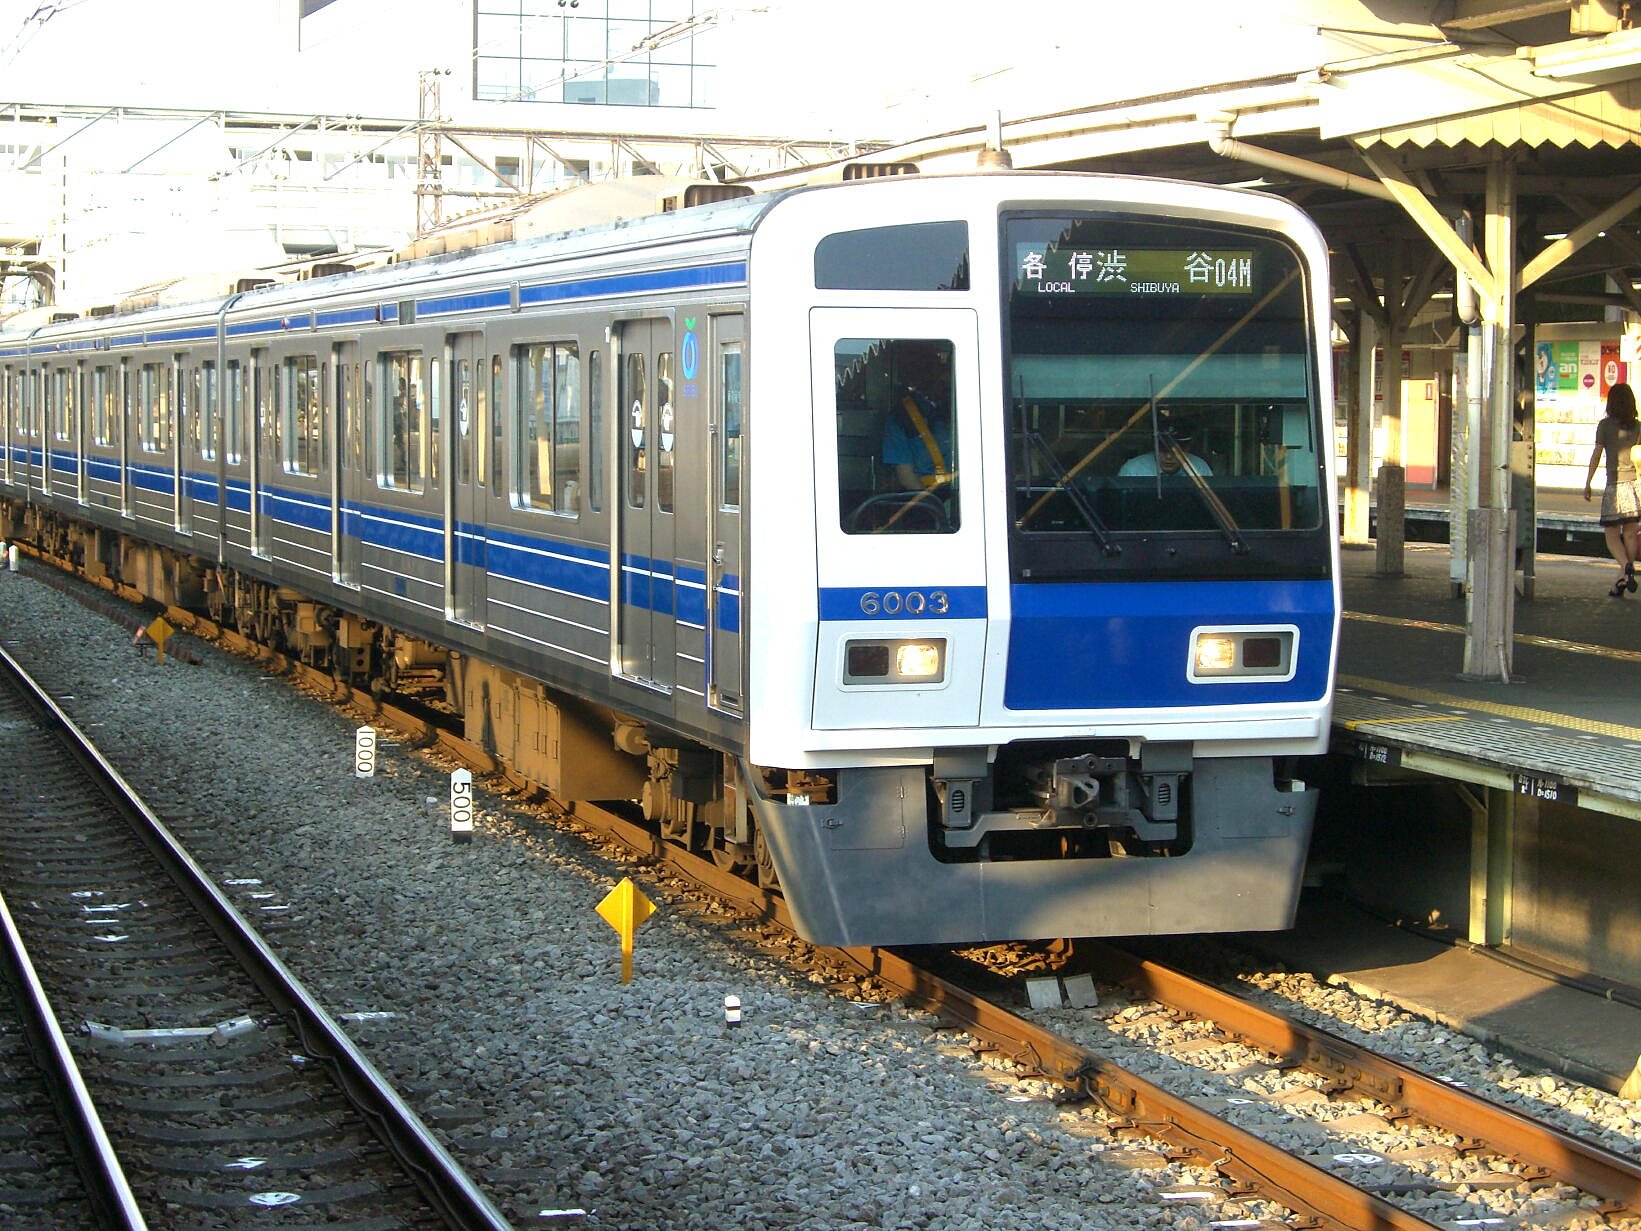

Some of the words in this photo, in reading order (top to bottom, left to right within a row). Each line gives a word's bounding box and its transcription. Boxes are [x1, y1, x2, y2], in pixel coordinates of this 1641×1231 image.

[1038, 282, 1075, 293] LOCAL
[1130, 282, 1180, 293] SHIBUYA
[1559, 363, 1577, 373] an
[860, 590, 949, 616] 6003
[357, 731, 375, 773] 1000
[452, 782, 471, 823] 500
